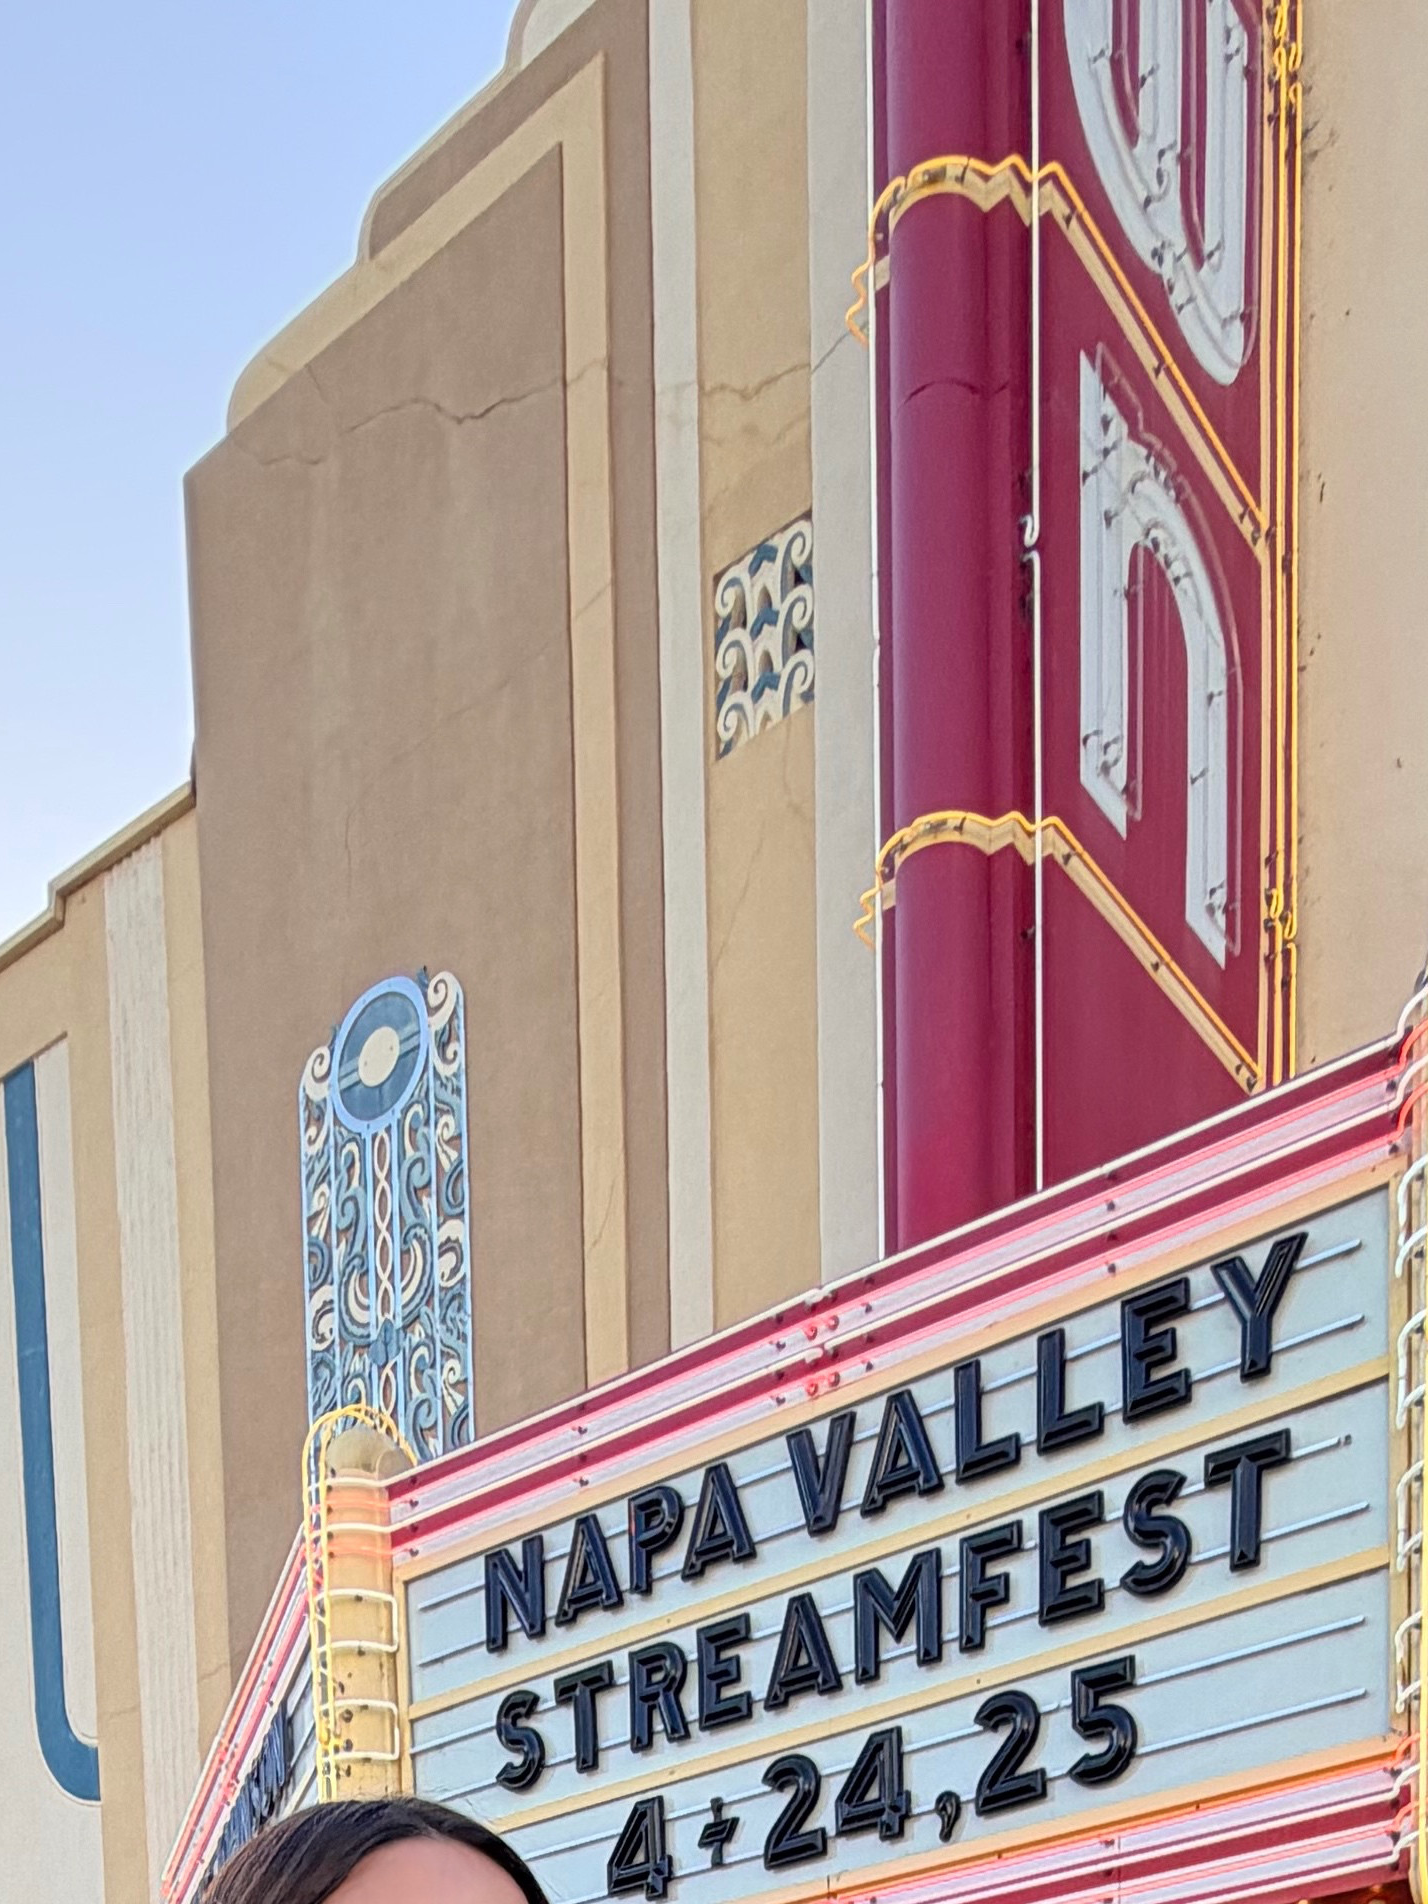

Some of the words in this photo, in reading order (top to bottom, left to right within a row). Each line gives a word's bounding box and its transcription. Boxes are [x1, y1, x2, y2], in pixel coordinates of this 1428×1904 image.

[484, 1465, 759, 1653] NAPA
[785, 1232, 1310, 1535] VALLEY
[494, 1428, 1293, 1791] STREAMFEST
